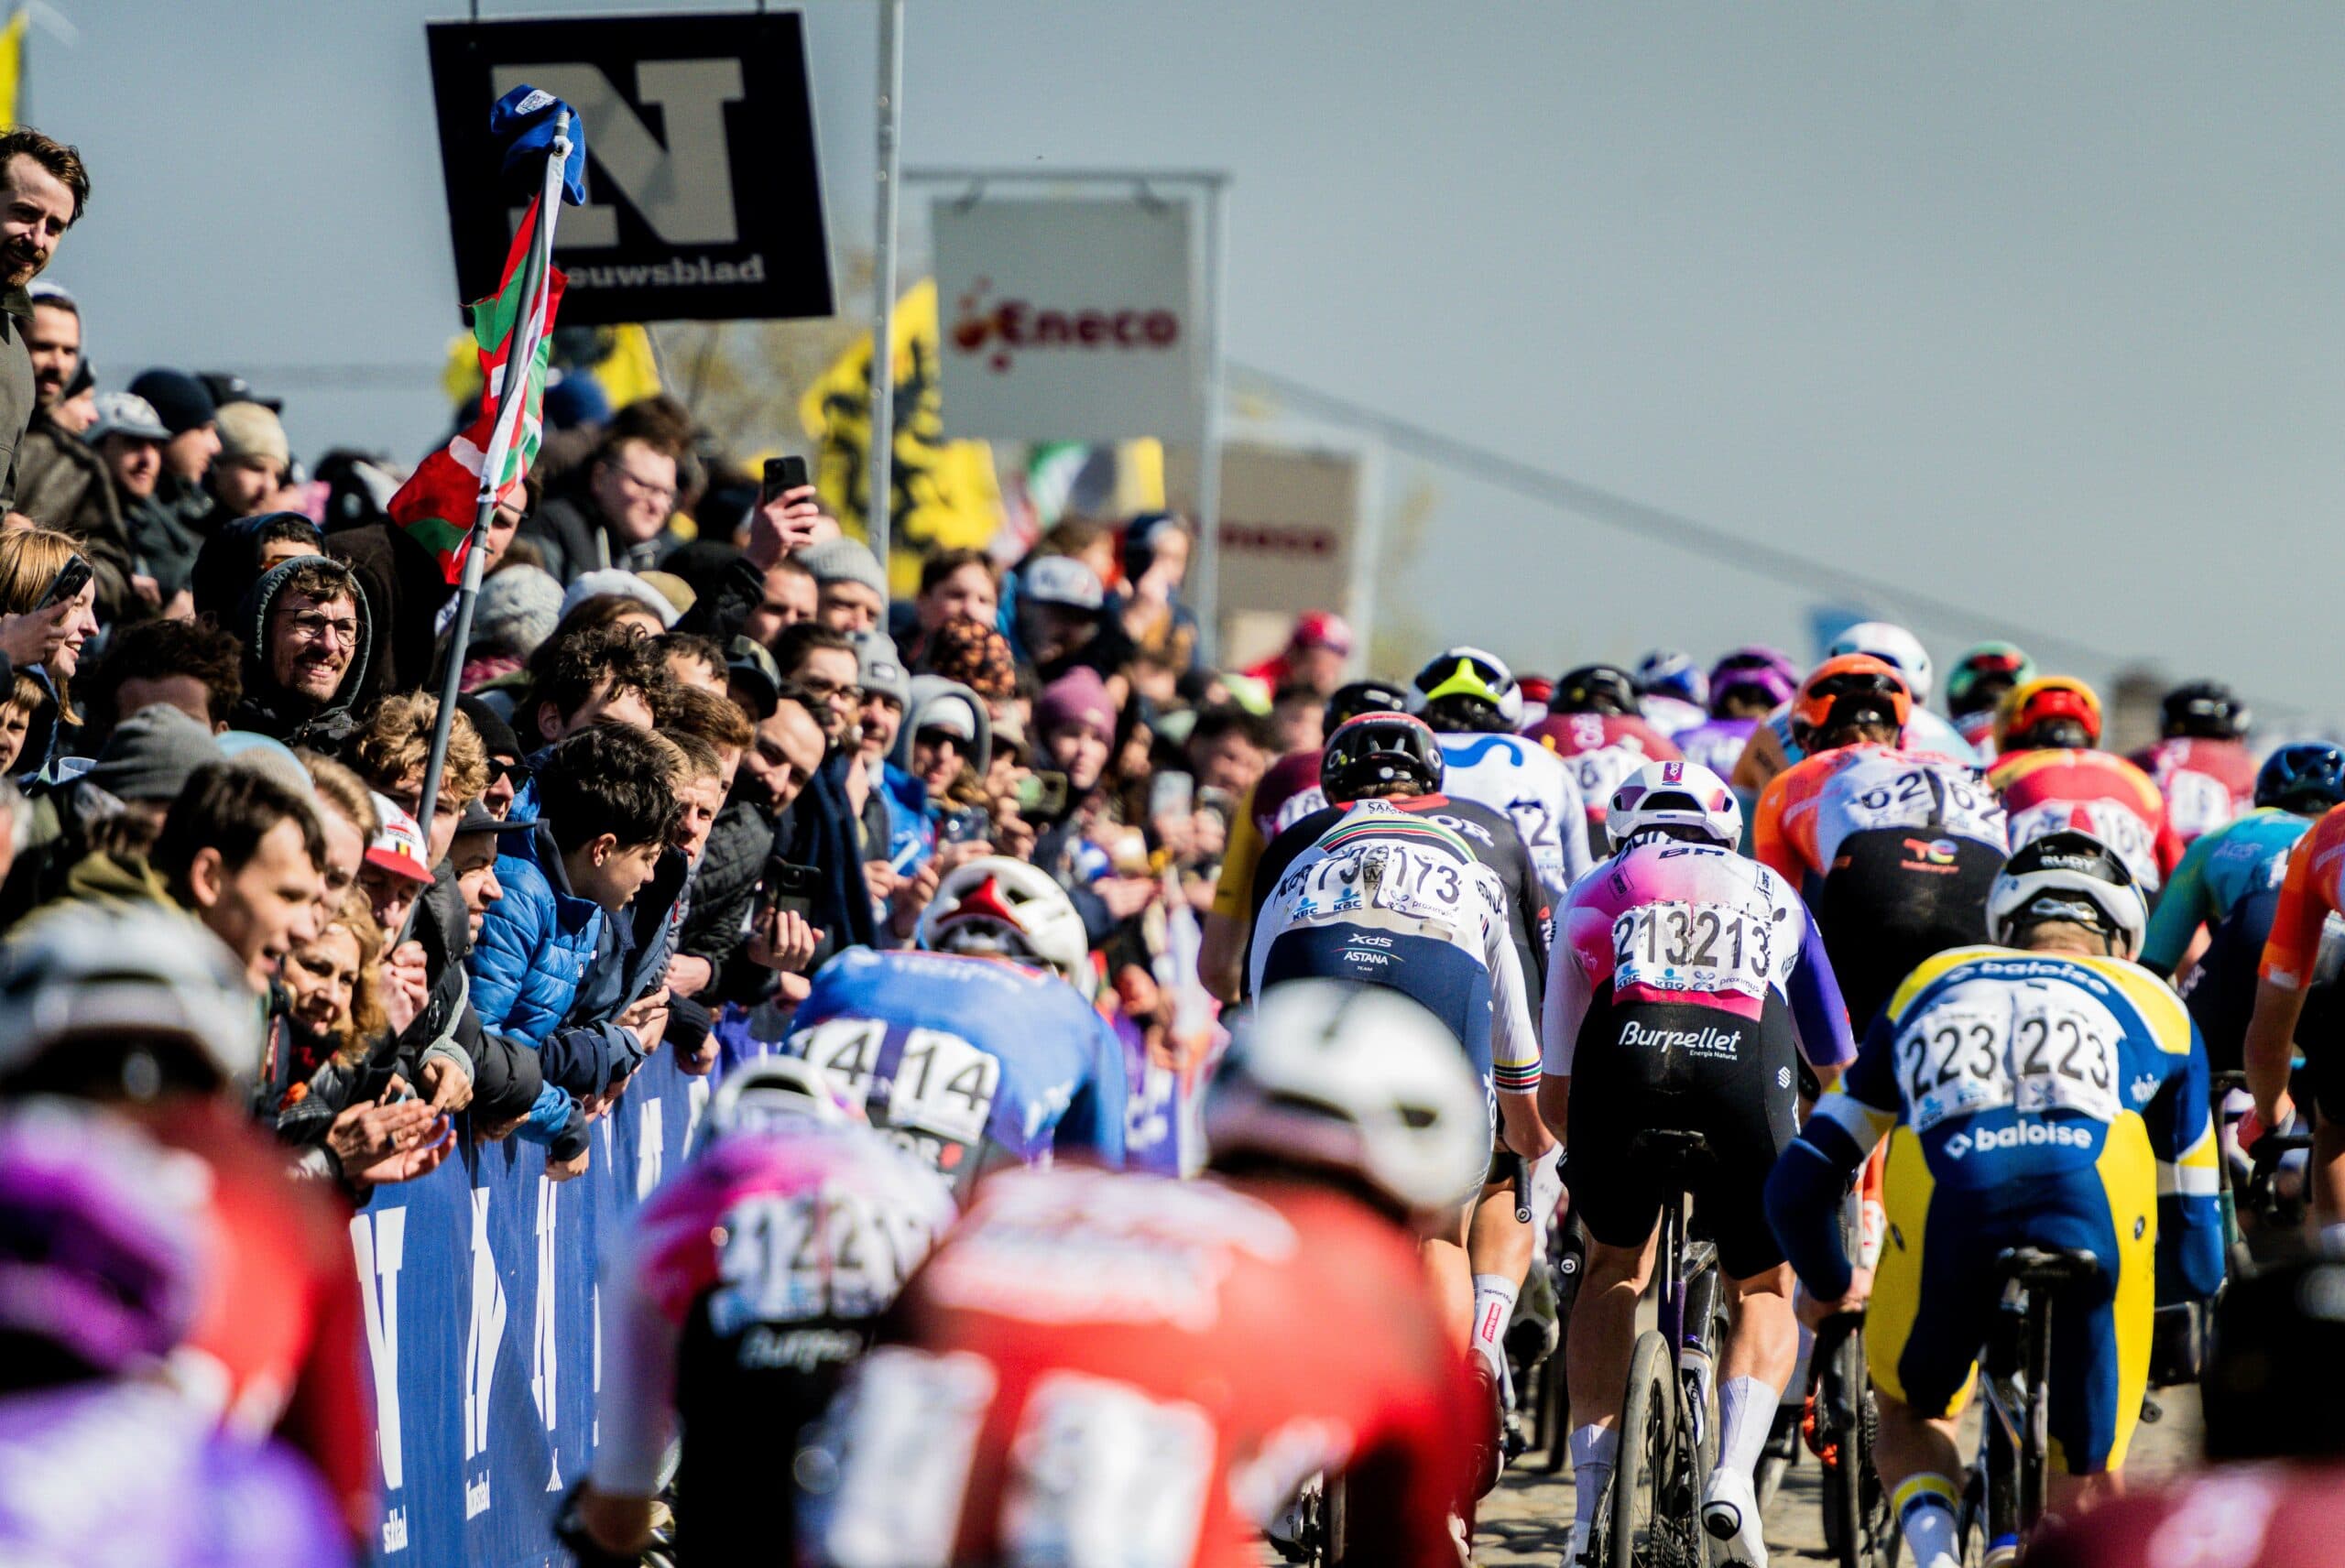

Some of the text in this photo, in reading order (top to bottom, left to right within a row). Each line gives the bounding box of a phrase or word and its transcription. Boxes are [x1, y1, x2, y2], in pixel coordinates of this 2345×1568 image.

[492, 59, 744, 247] N
[555, 253, 766, 289] euwsblad
[997, 299, 1180, 349] Eneco
[1292, 907, 1319, 921] KBC
[1333, 899, 1362, 911] KBC
[1344, 951, 1389, 965] ASTANA
[1613, 909, 1691, 968] 213
[1694, 910, 1773, 978] 213
[1619, 1020, 1741, 1053] Burpellet
[1714, 1051, 1738, 1061] Natural
[2022, 1017, 2110, 1090] 223
[905, 1044, 993, 1111] 14
[1906, 1024, 1996, 1102] 223
[1975, 1118, 2093, 1152] baloise
